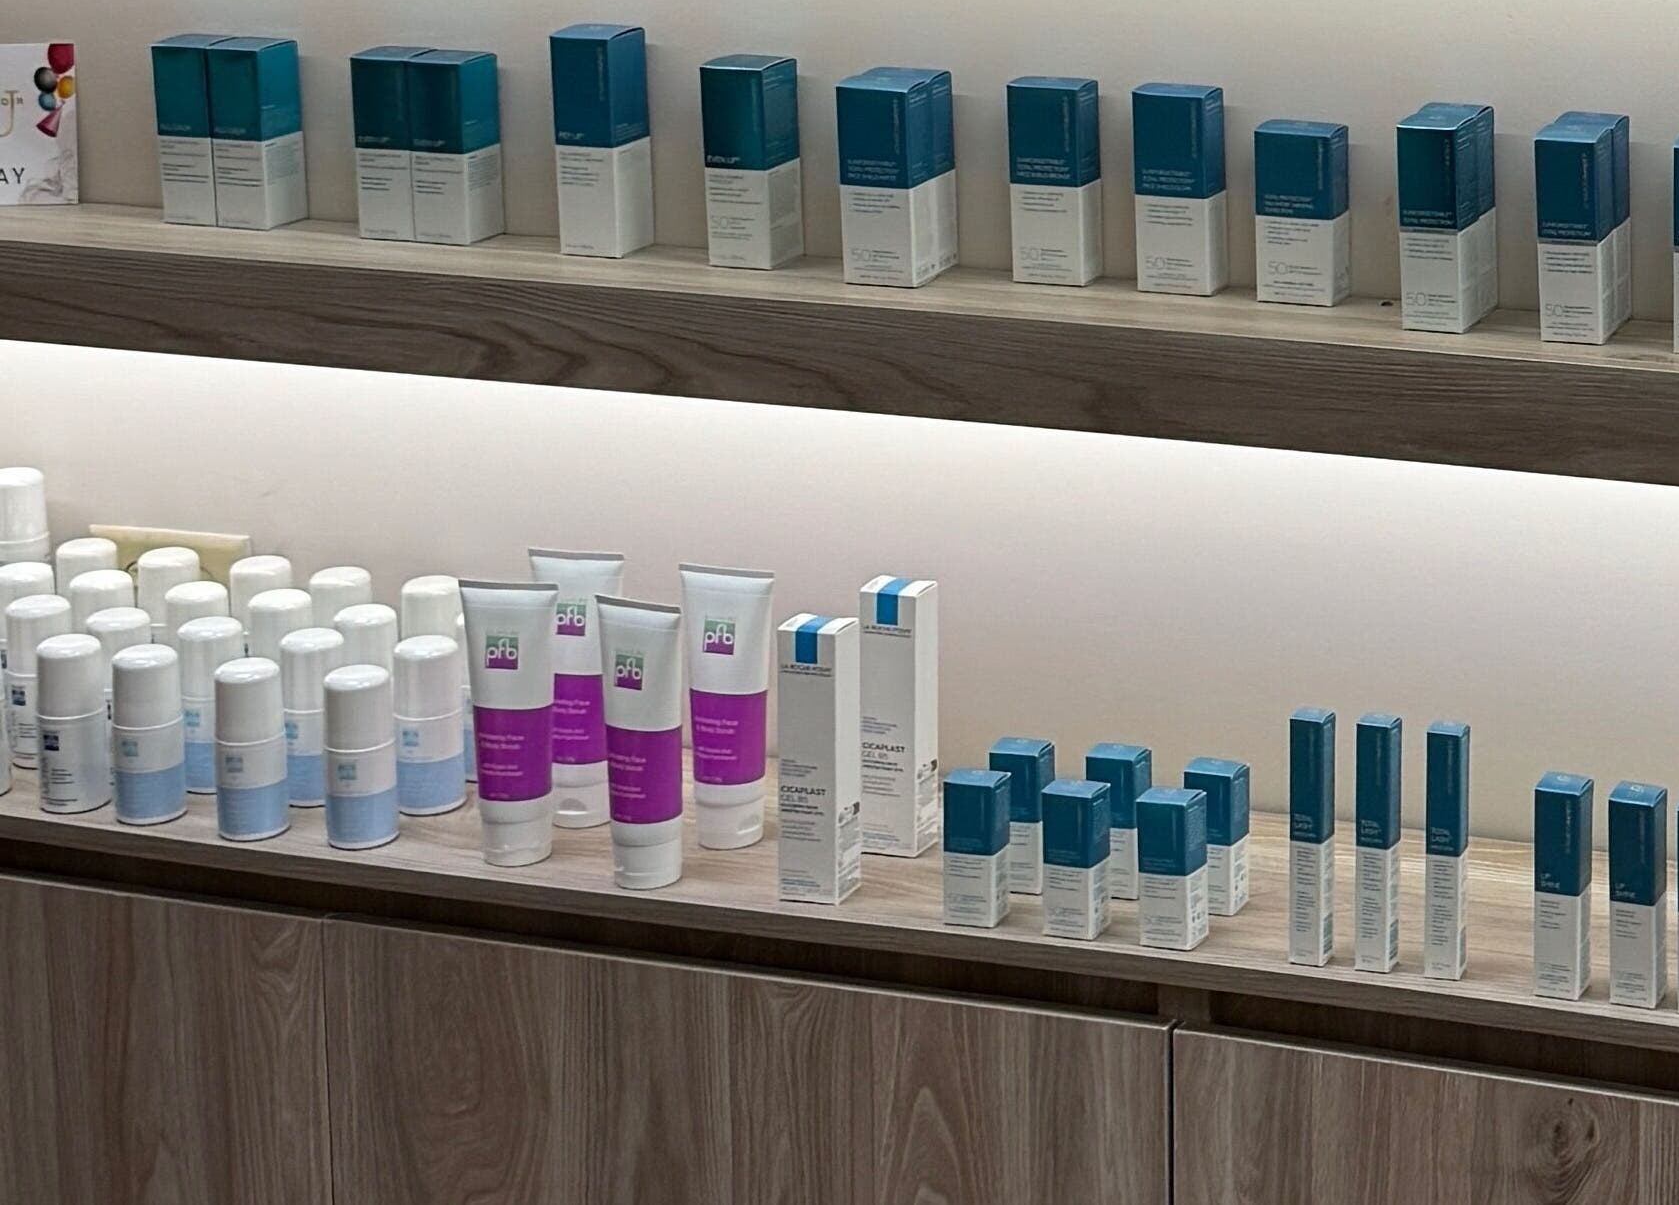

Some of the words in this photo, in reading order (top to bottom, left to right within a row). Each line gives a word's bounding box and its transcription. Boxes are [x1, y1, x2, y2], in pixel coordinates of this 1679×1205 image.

[556, 606, 586, 633] pfb
[704, 623, 734, 653] pfb
[486, 638, 518, 668] pfb
[614, 658, 642, 686] pfb
